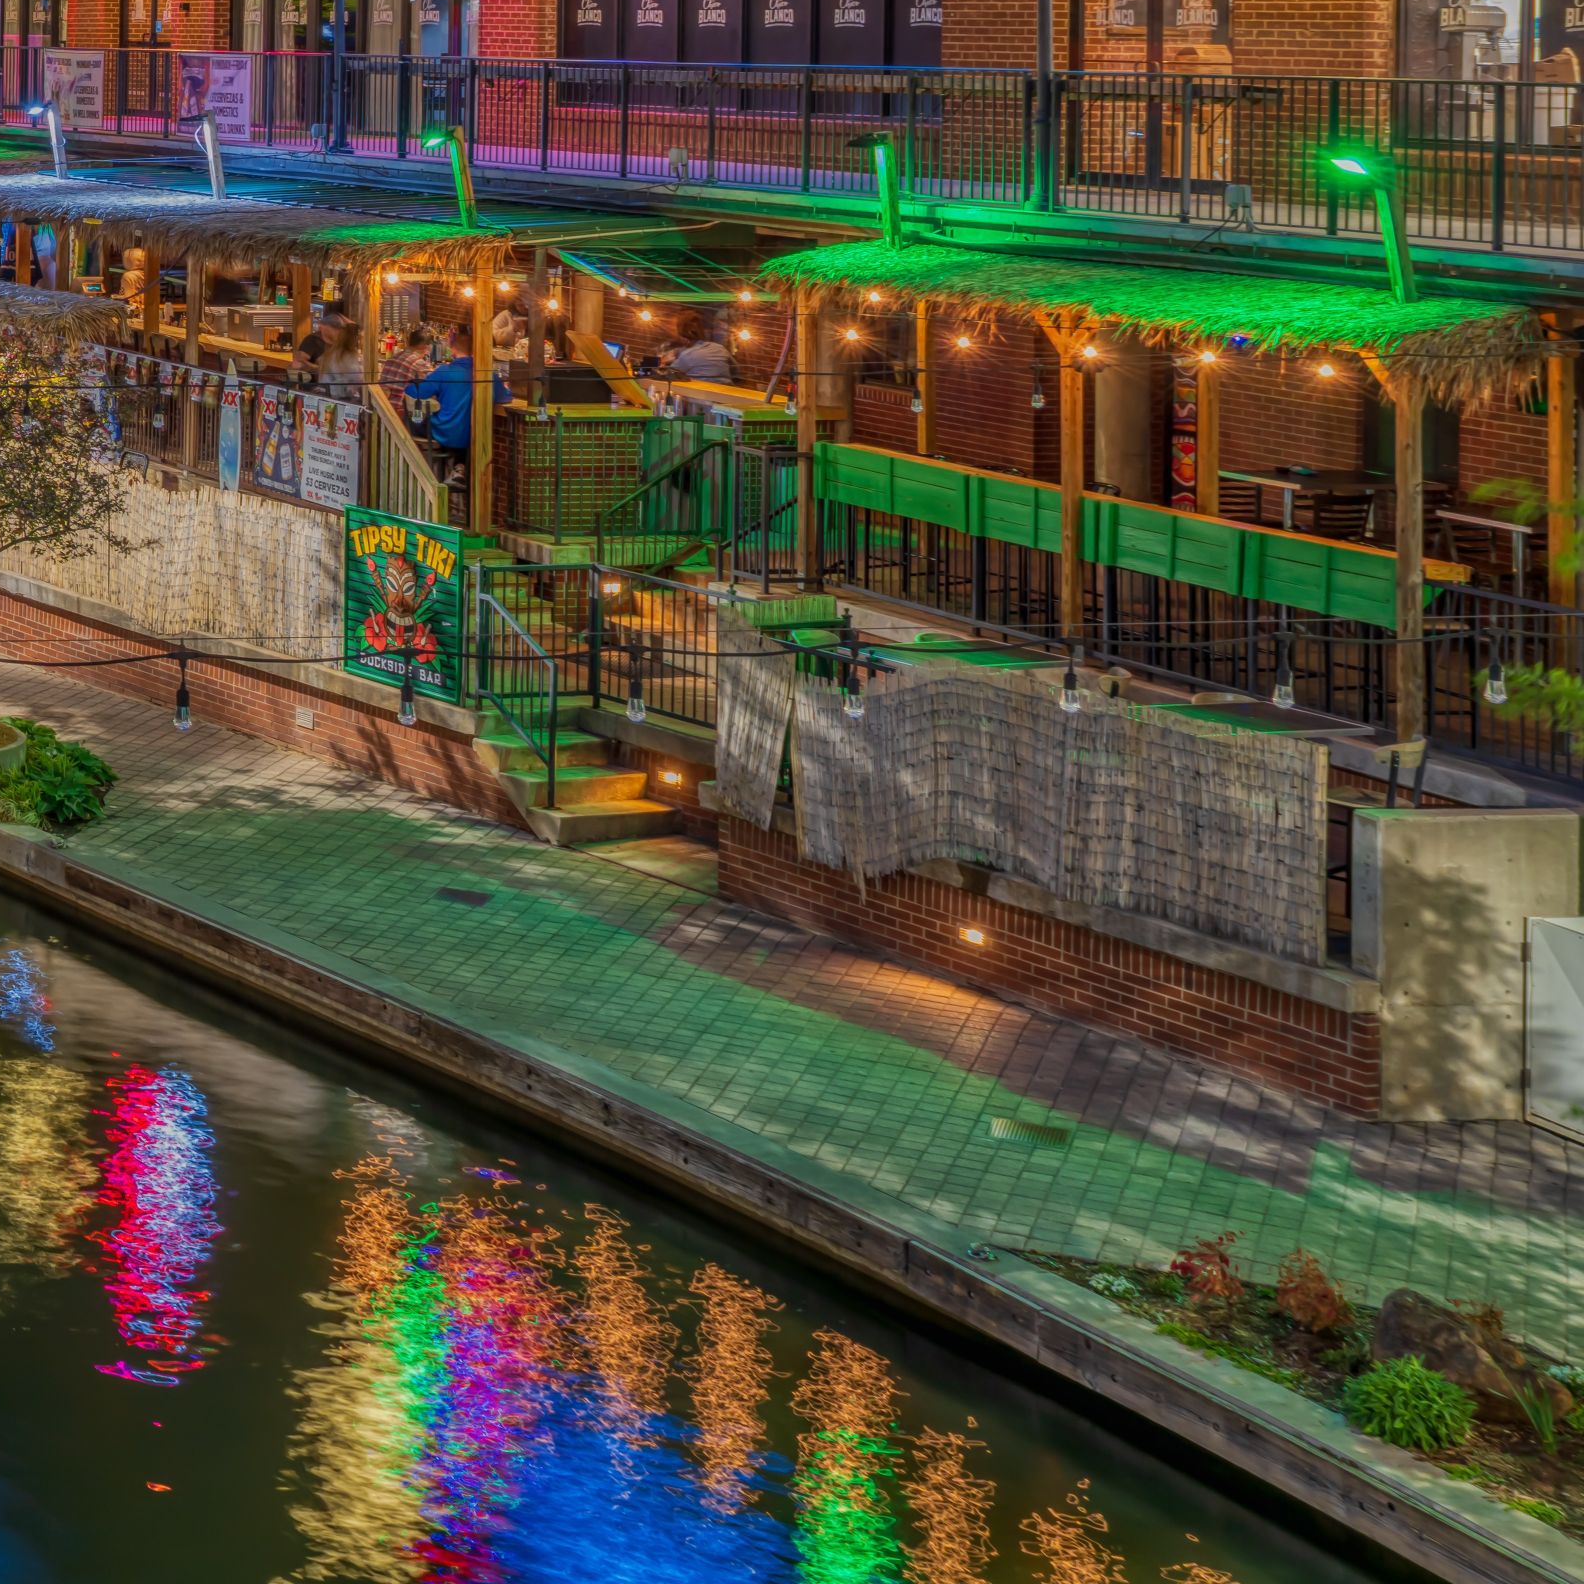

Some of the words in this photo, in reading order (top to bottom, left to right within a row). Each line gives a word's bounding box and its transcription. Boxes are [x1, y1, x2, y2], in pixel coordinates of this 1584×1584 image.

[577, 9, 602, 23] BLANCO
[637, 9, 663, 23] BLANCO
[698, 9, 726, 23] BLANCO
[764, 9, 794, 24] BLANCO
[834, 9, 866, 24] BLANCO
[910, 8, 943, 23] BLANCO
[1176, 9, 1219, 26] BLANCO
[222, 391, 239, 407] XX
[344, 418, 358, 436] XX
[308, 467, 320, 476] LIVE
[320, 469, 334, 480] MUSIC
[335, 474, 348, 484] AND
[314, 479, 350, 498] CERVEZAS
[350, 525, 407, 557] TIPSY
[415, 532, 456, 580] TIKI
[419, 669, 442, 685] BAR
